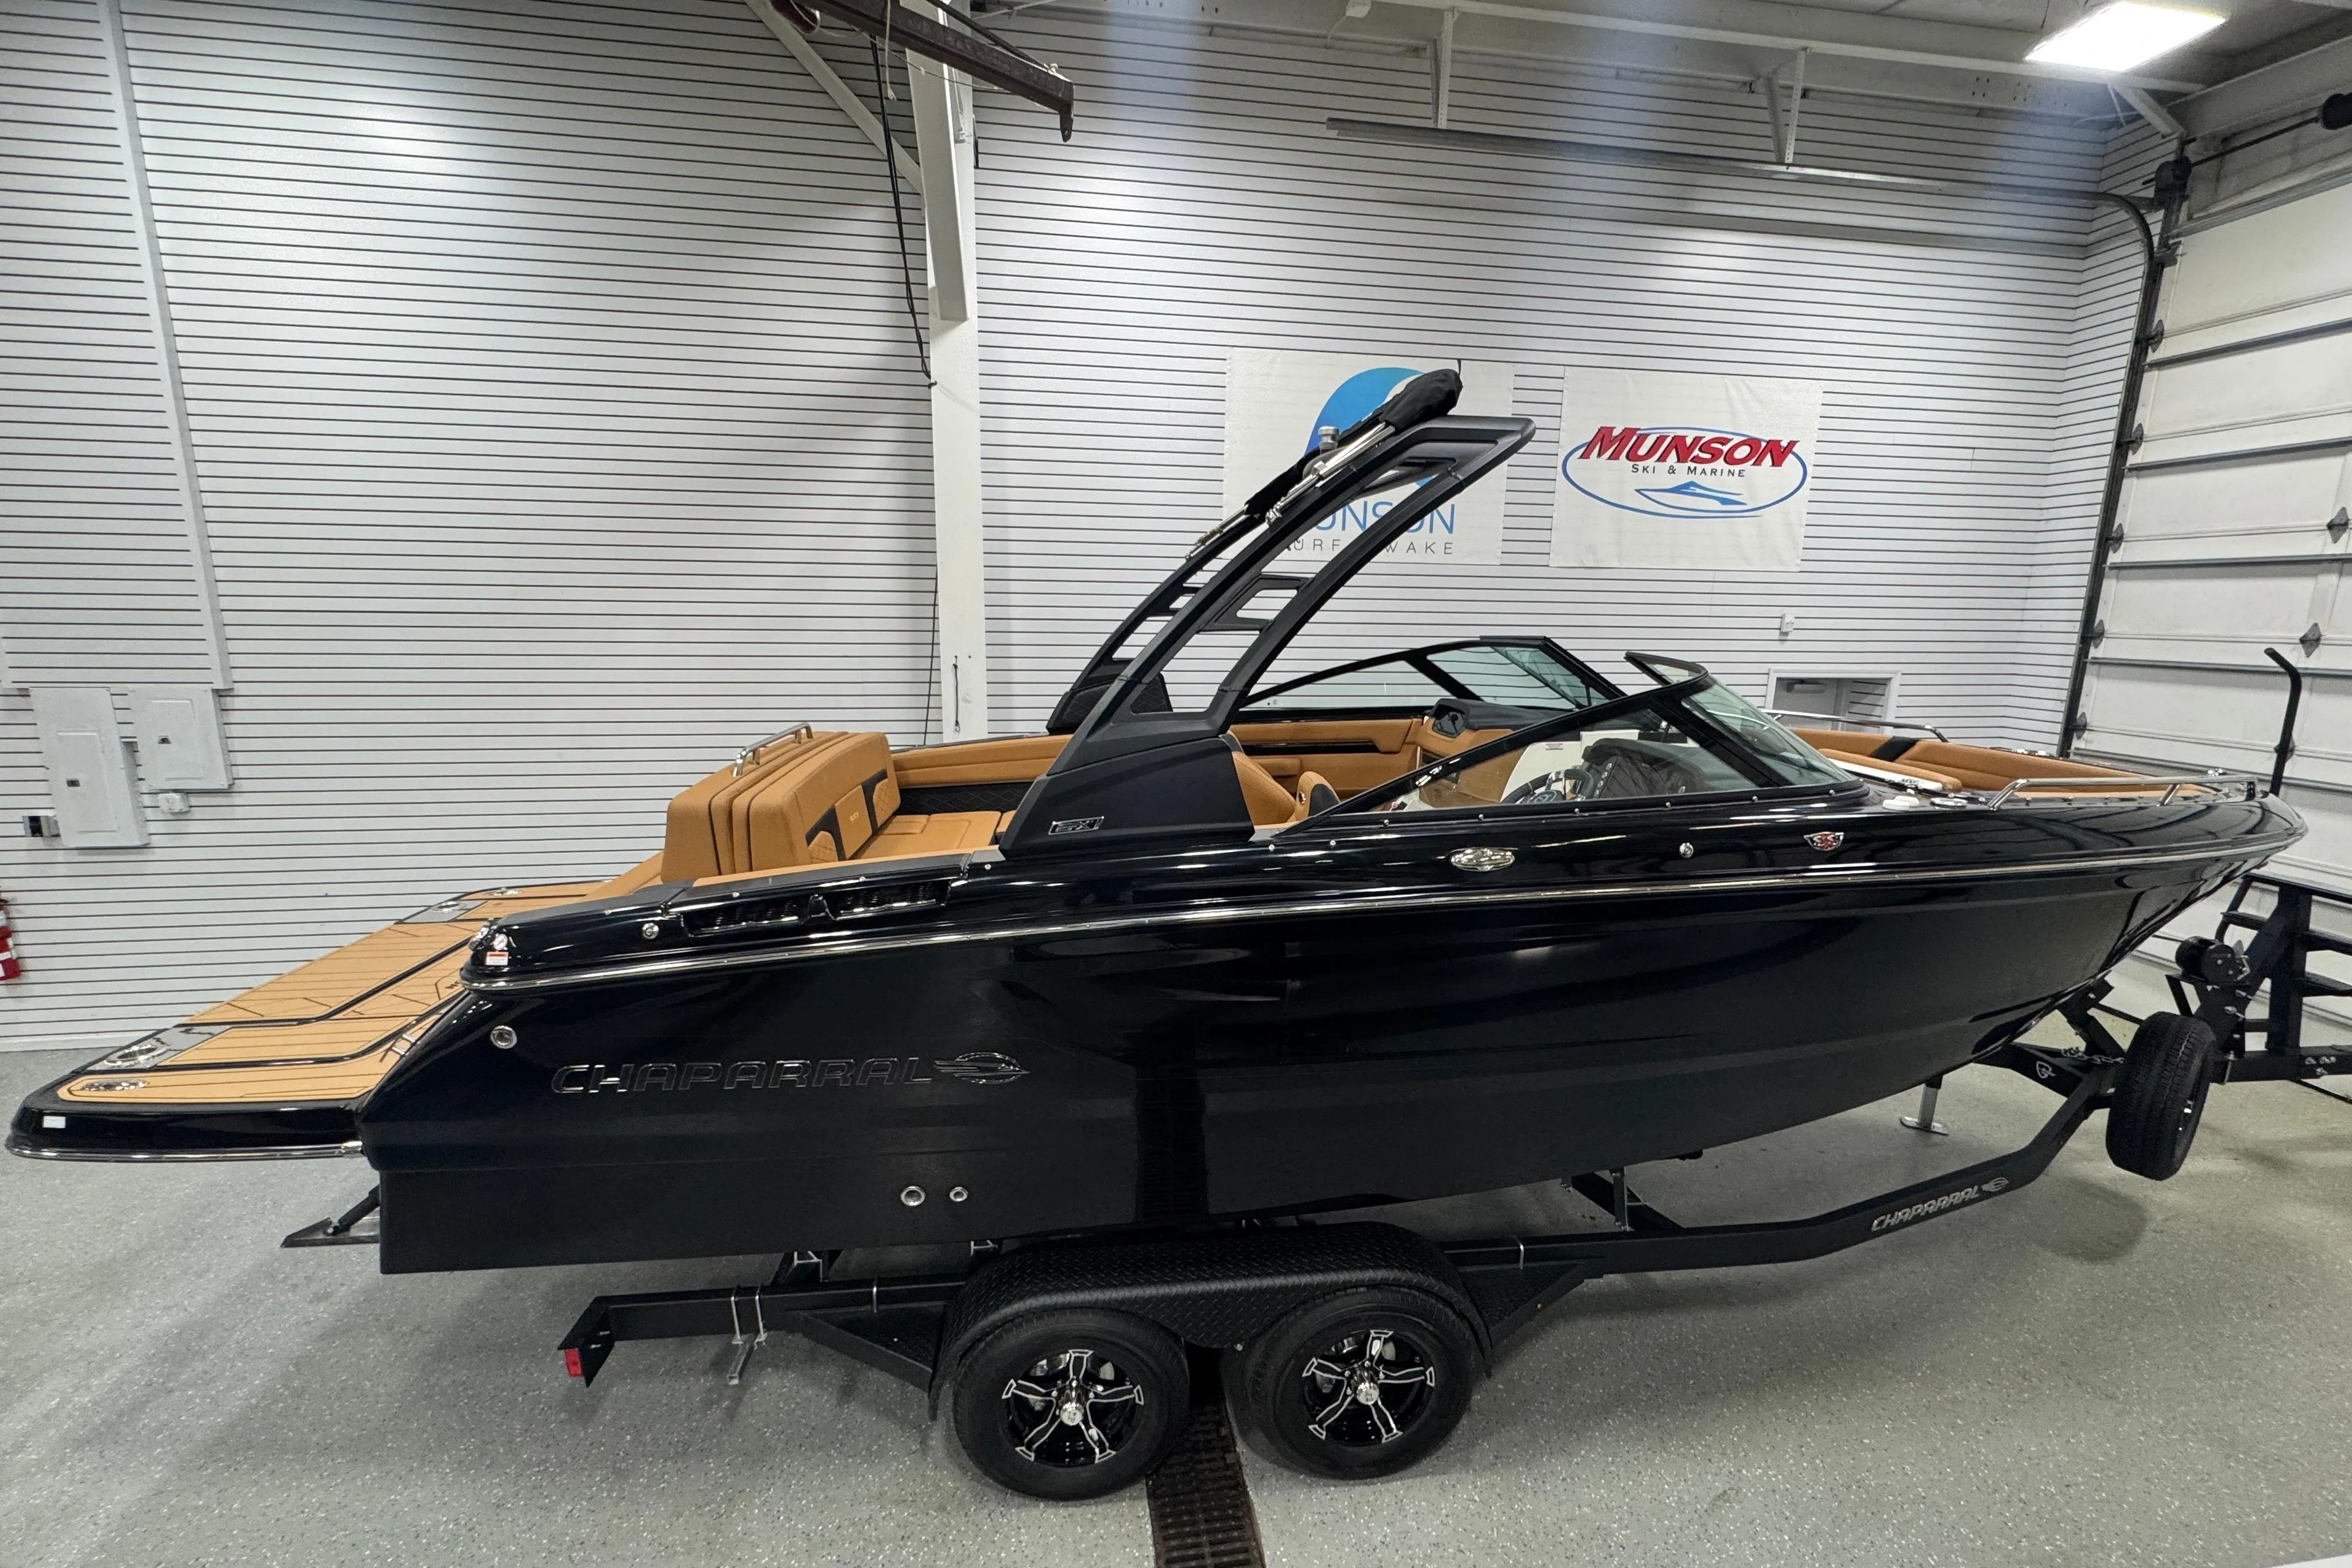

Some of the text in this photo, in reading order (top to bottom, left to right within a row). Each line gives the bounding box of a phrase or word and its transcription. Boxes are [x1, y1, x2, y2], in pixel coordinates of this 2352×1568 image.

[1577, 426, 1801, 467] MUNSON
[1631, 464, 1746, 478] SKI & MARINE
[1293, 538, 1453, 555] URF WAKE
[551, 1057, 932, 1093] CHAPARRAL
[1871, 1185, 1980, 1232] CHAPARRAL
